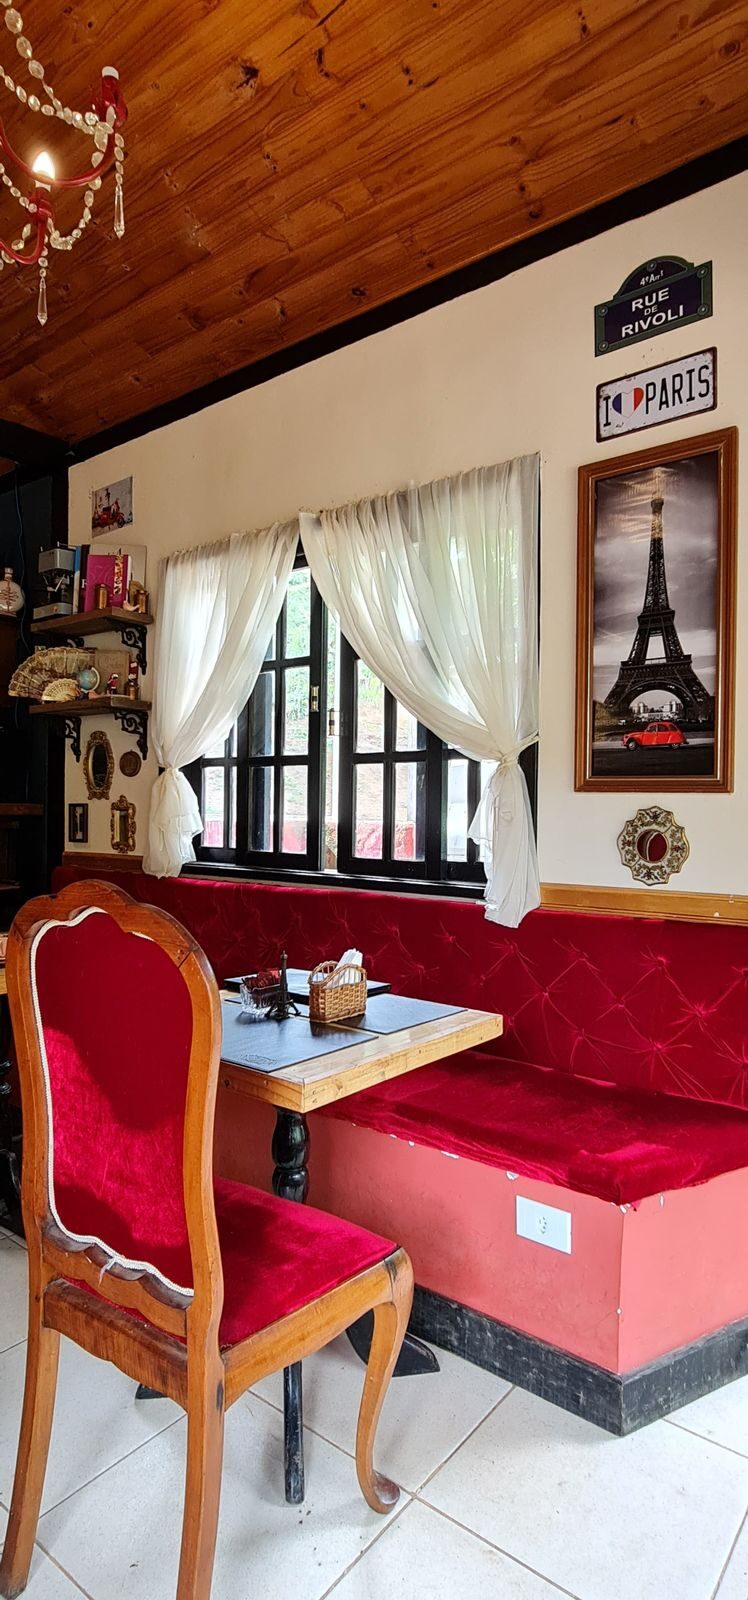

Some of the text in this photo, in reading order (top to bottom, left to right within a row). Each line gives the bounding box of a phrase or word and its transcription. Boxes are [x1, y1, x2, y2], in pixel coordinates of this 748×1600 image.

[631, 288, 670, 312] RUE
[644, 305, 658, 316] DE
[621, 305, 684, 338] RIVOLI
[603, 365, 710, 428] I PARIS
